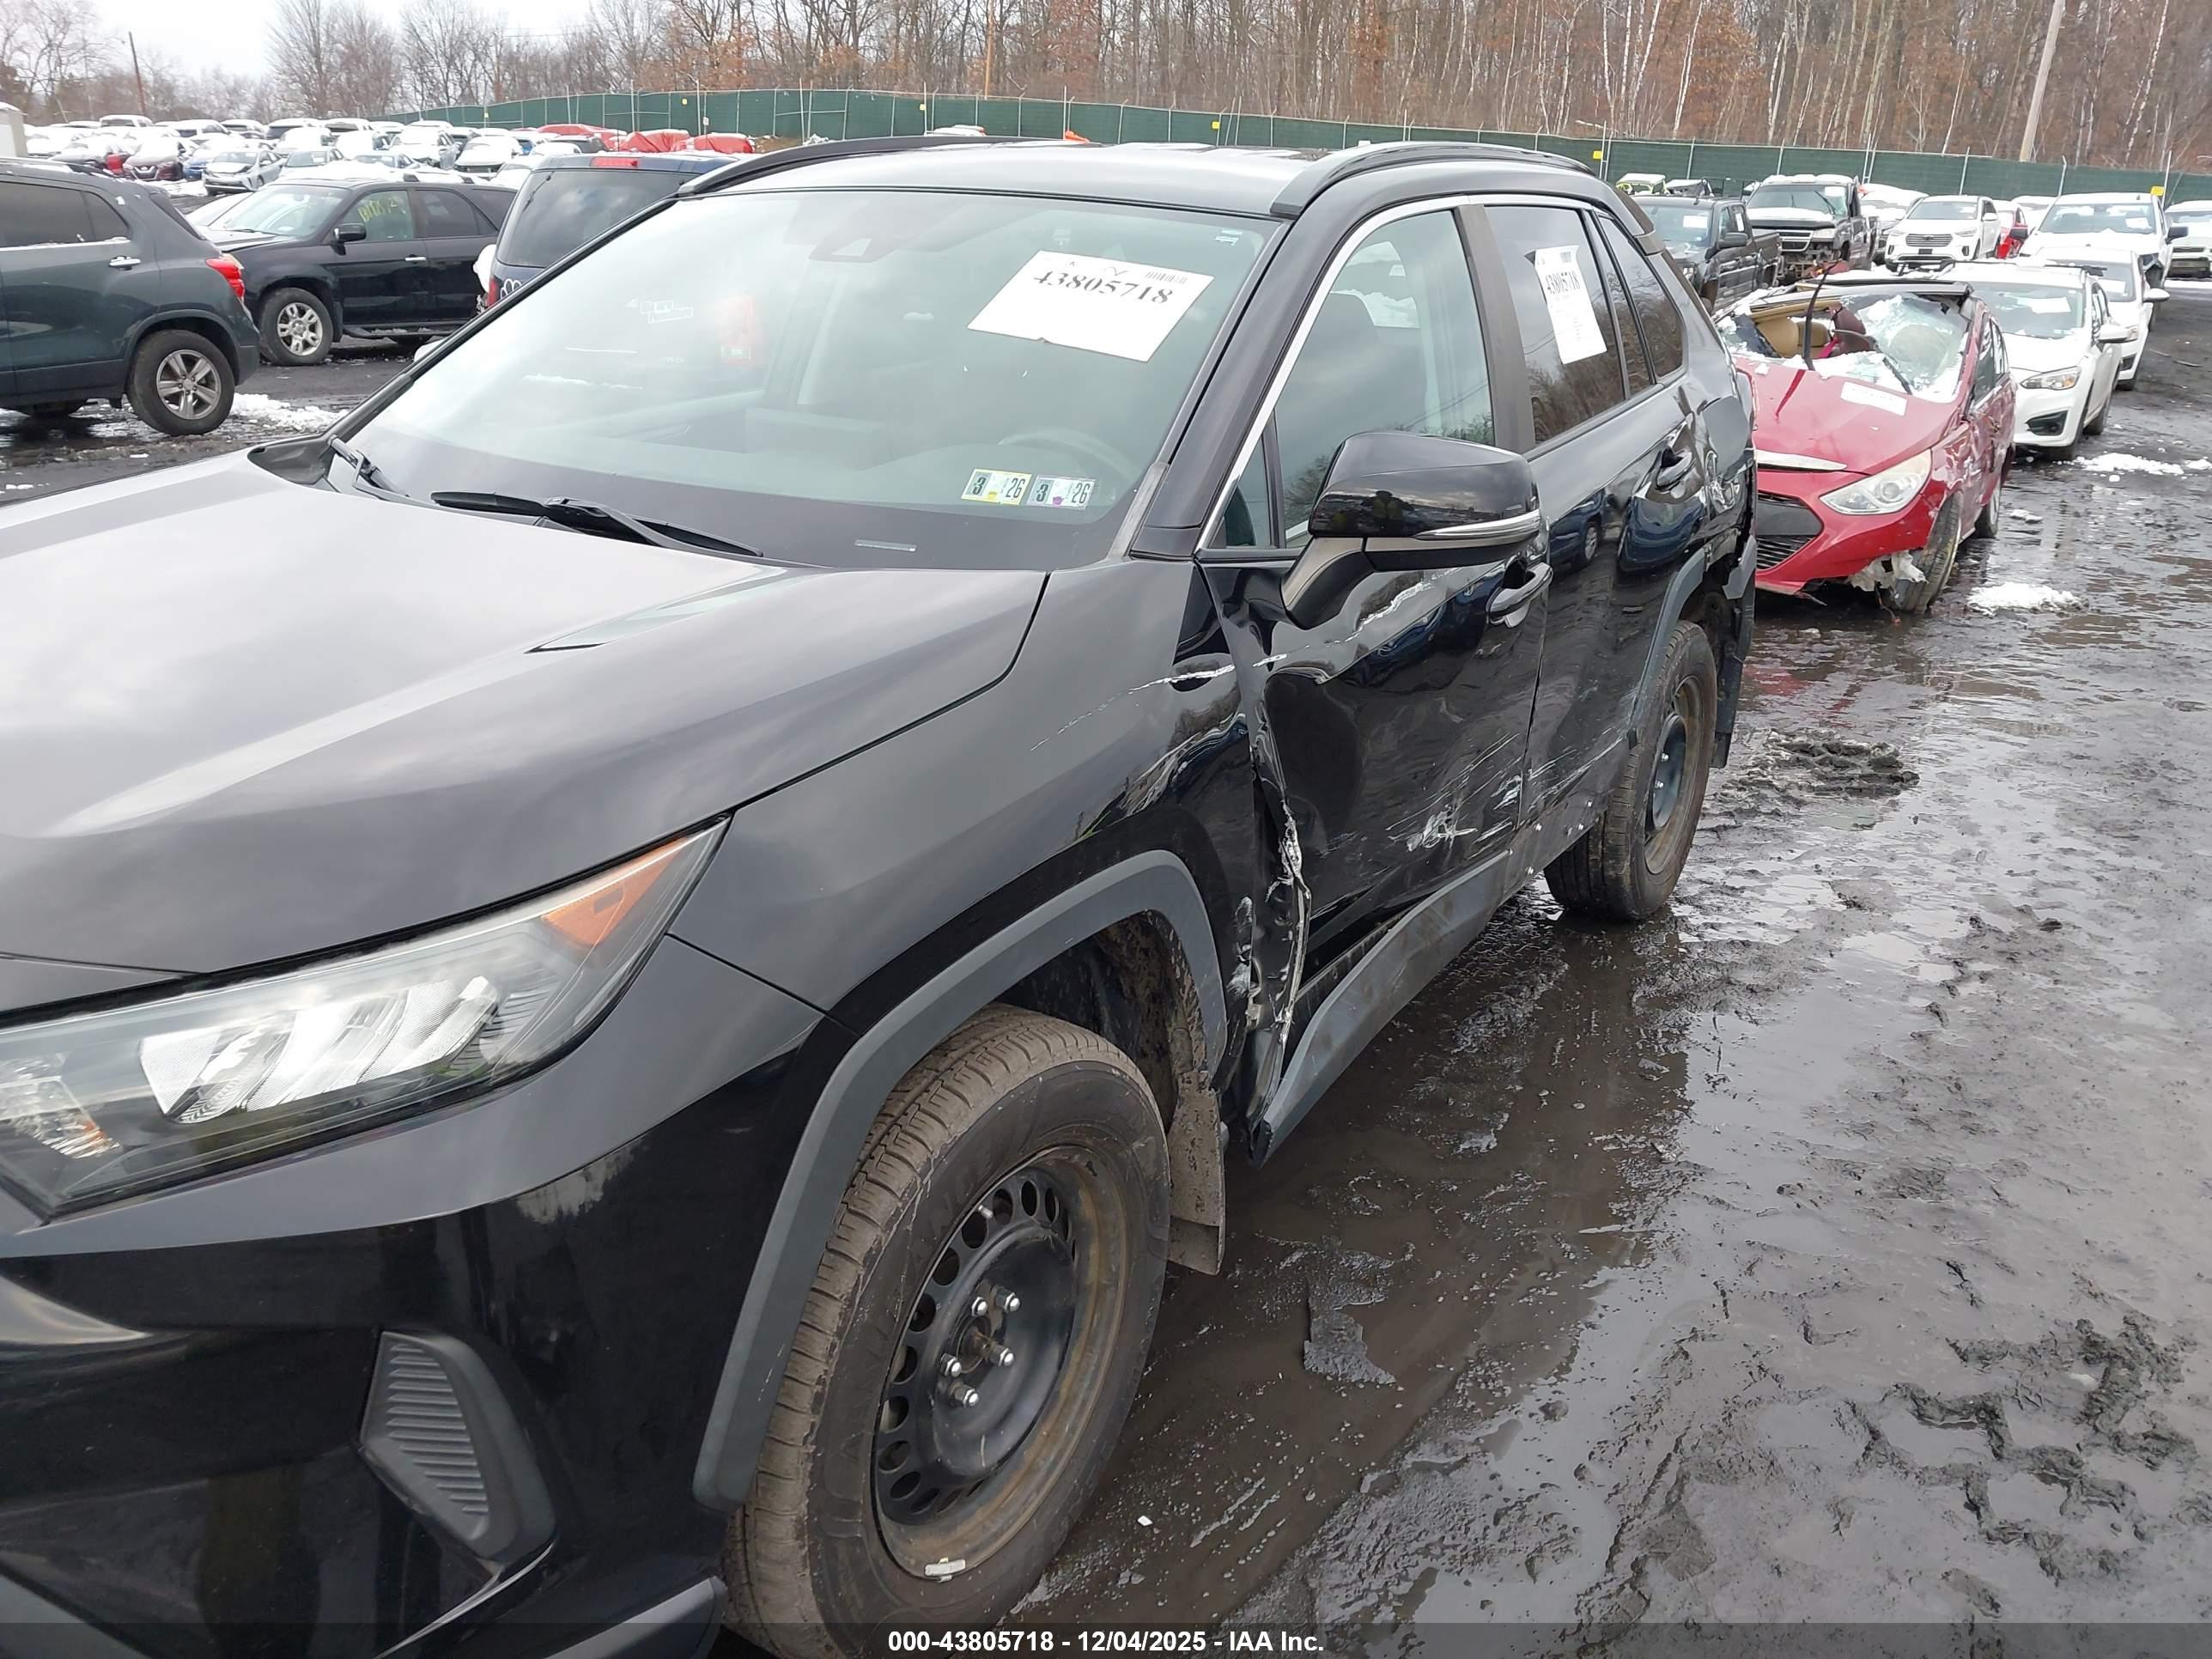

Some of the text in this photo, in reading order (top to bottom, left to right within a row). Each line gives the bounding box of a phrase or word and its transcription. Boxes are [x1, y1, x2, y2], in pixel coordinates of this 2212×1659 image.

[1034, 270, 1173, 303] 43805718
[972, 477, 1025, 498] 3 26
[1036, 483, 1091, 503] 3 26
